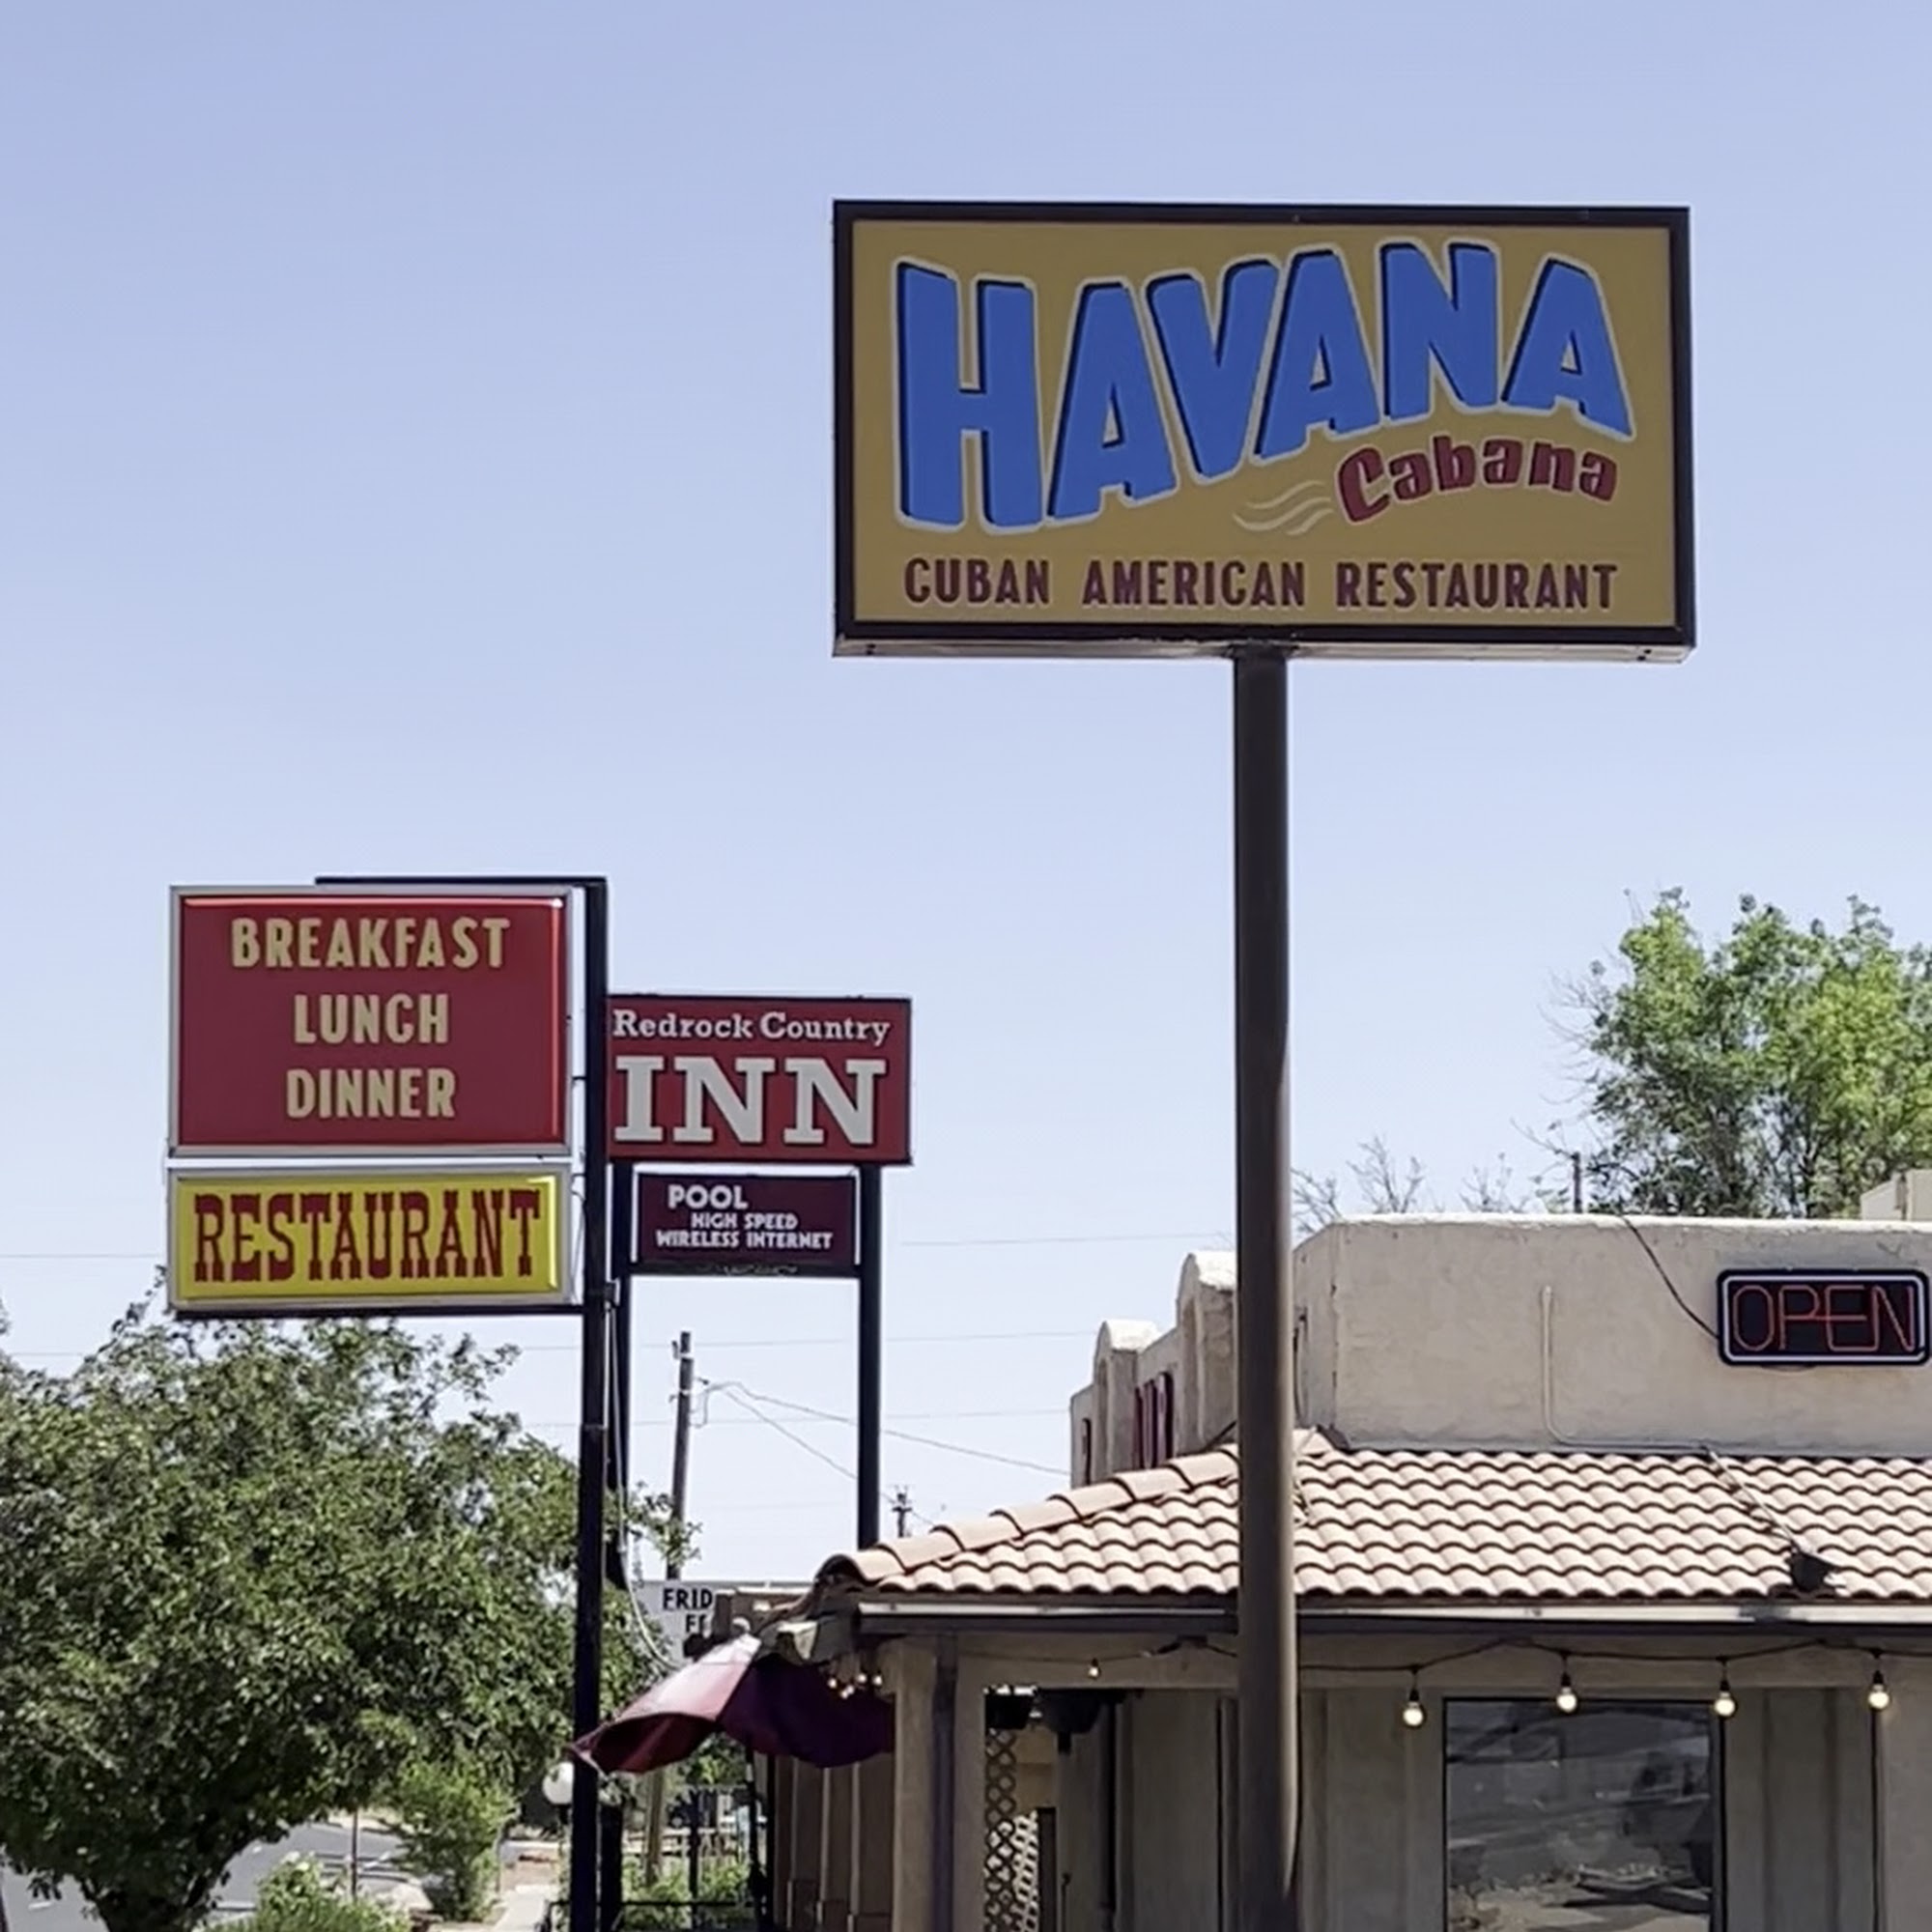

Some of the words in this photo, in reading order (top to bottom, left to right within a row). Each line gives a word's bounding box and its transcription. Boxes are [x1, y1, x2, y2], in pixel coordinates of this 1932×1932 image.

[897, 240, 1634, 530] HAVANA
[1337, 434, 1618, 524] Cabana
[904, 557, 1050, 607] CUBAN
[1082, 559, 1305, 609] AMERICAN
[1337, 561, 1618, 611] RESTAURANT
[231, 917, 510, 969] BREAKFAST
[294, 993, 448, 1044] LUNCH
[612, 1009, 753, 1038] Redrock
[760, 1011, 891, 1045] Country
[286, 1067, 457, 1119] DINNER
[614, 1056, 887, 1145] INN
[668, 1184, 749, 1209] POOL
[691, 1212, 738, 1230] HIGH
[744, 1213, 799, 1230] SPEED
[194, 1188, 541, 1282] RESTAURANT
[656, 1230, 740, 1248] WIRELESS
[747, 1231, 834, 1249] INTERNET
[1732, 1284, 1916, 1351] OPEN
